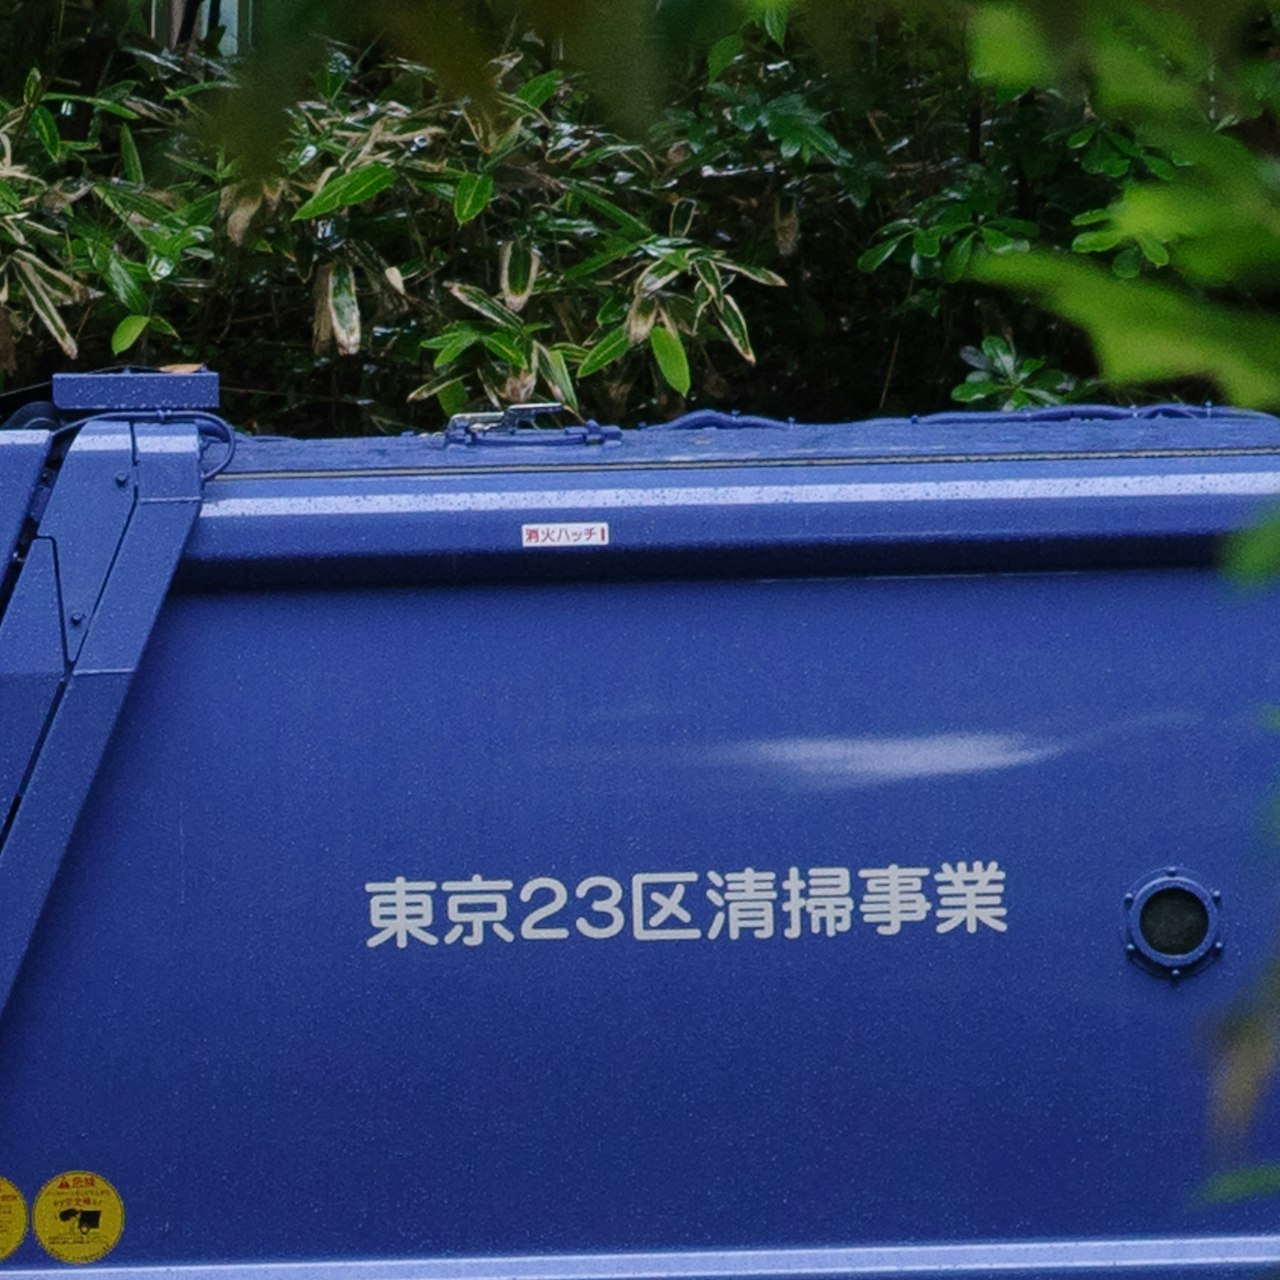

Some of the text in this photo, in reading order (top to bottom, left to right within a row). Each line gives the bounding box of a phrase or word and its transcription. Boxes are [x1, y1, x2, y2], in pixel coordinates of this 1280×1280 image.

[364, 859, 1009, 949] 東京23区清掃事業
